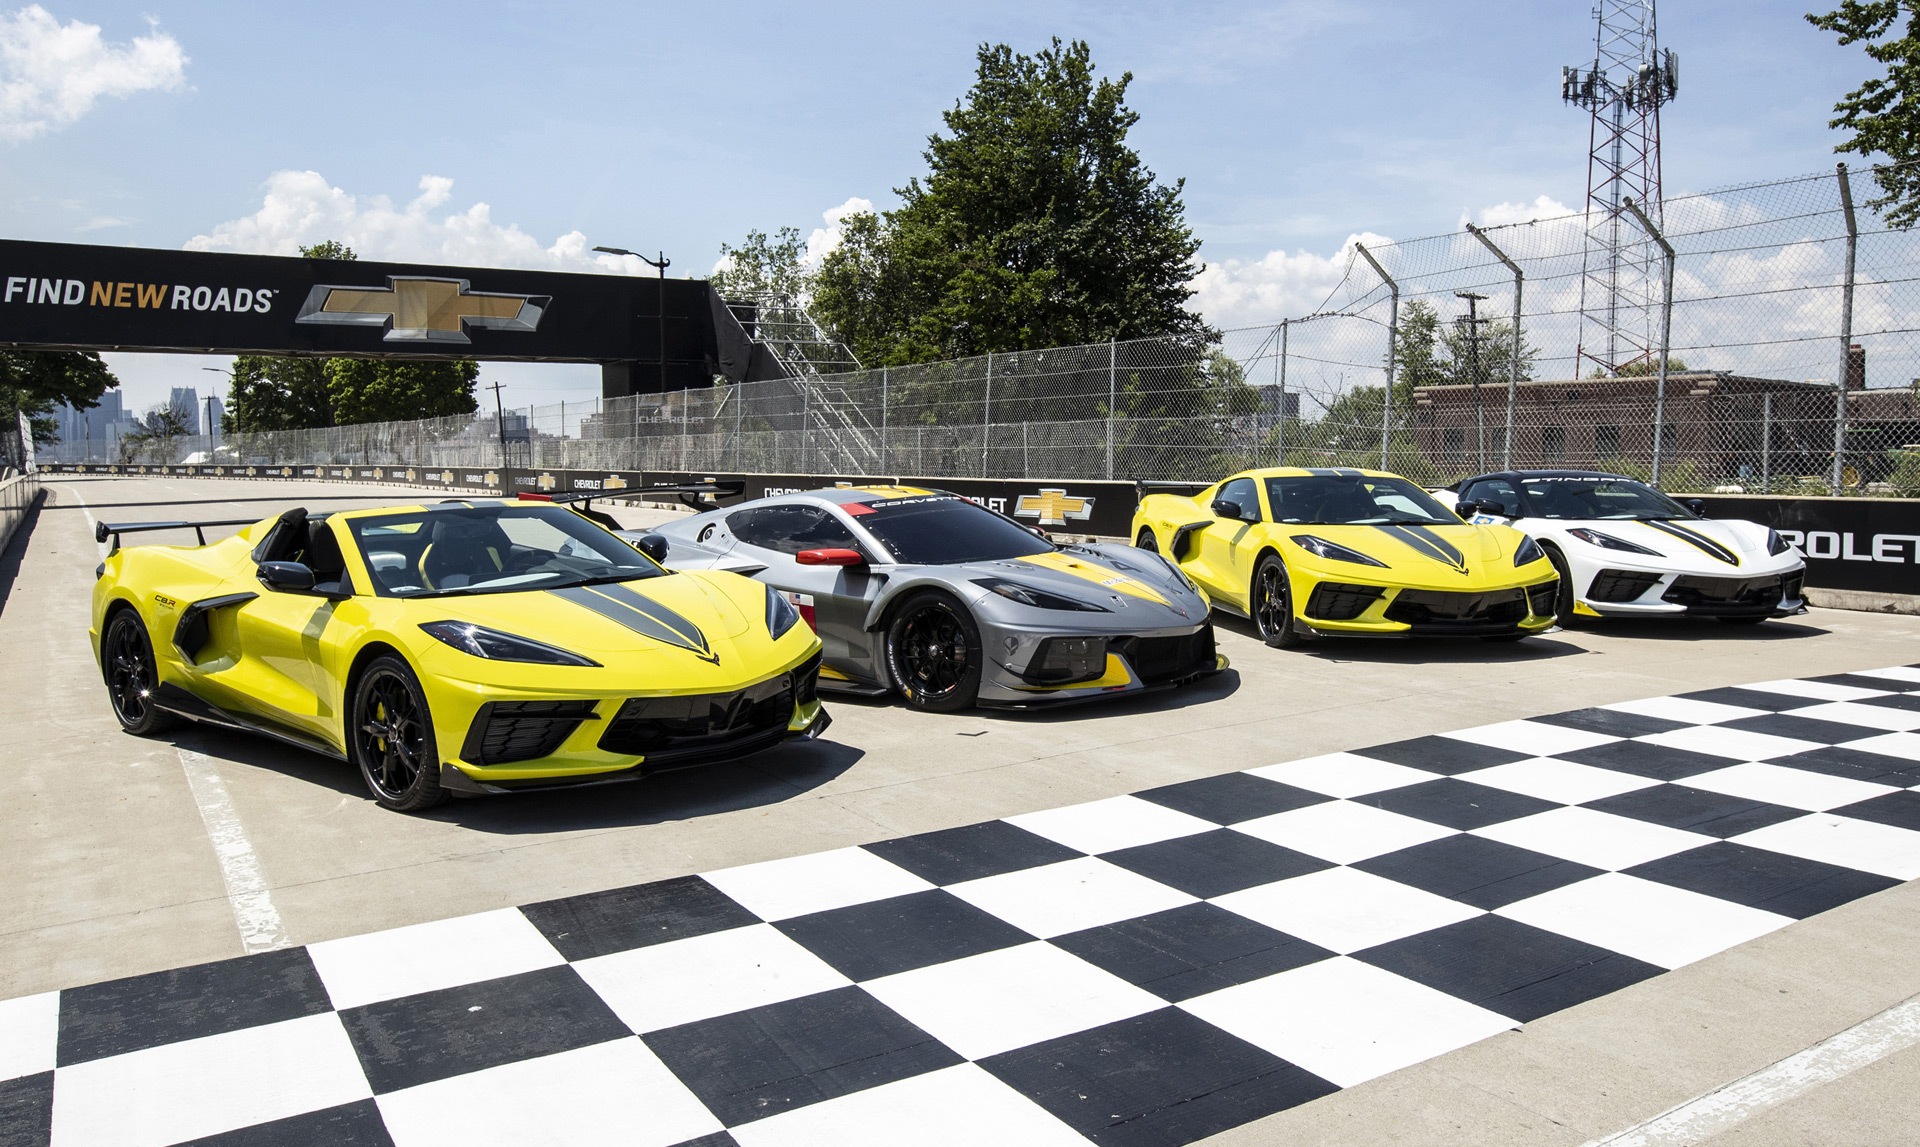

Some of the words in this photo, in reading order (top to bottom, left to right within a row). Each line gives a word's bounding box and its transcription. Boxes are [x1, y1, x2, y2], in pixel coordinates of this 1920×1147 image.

[4, 276, 85, 305] FIND
[90, 280, 168, 309] NEW
[638, 415, 705, 424] CHEROLET
[574, 479, 601, 490] CHEVROLET
